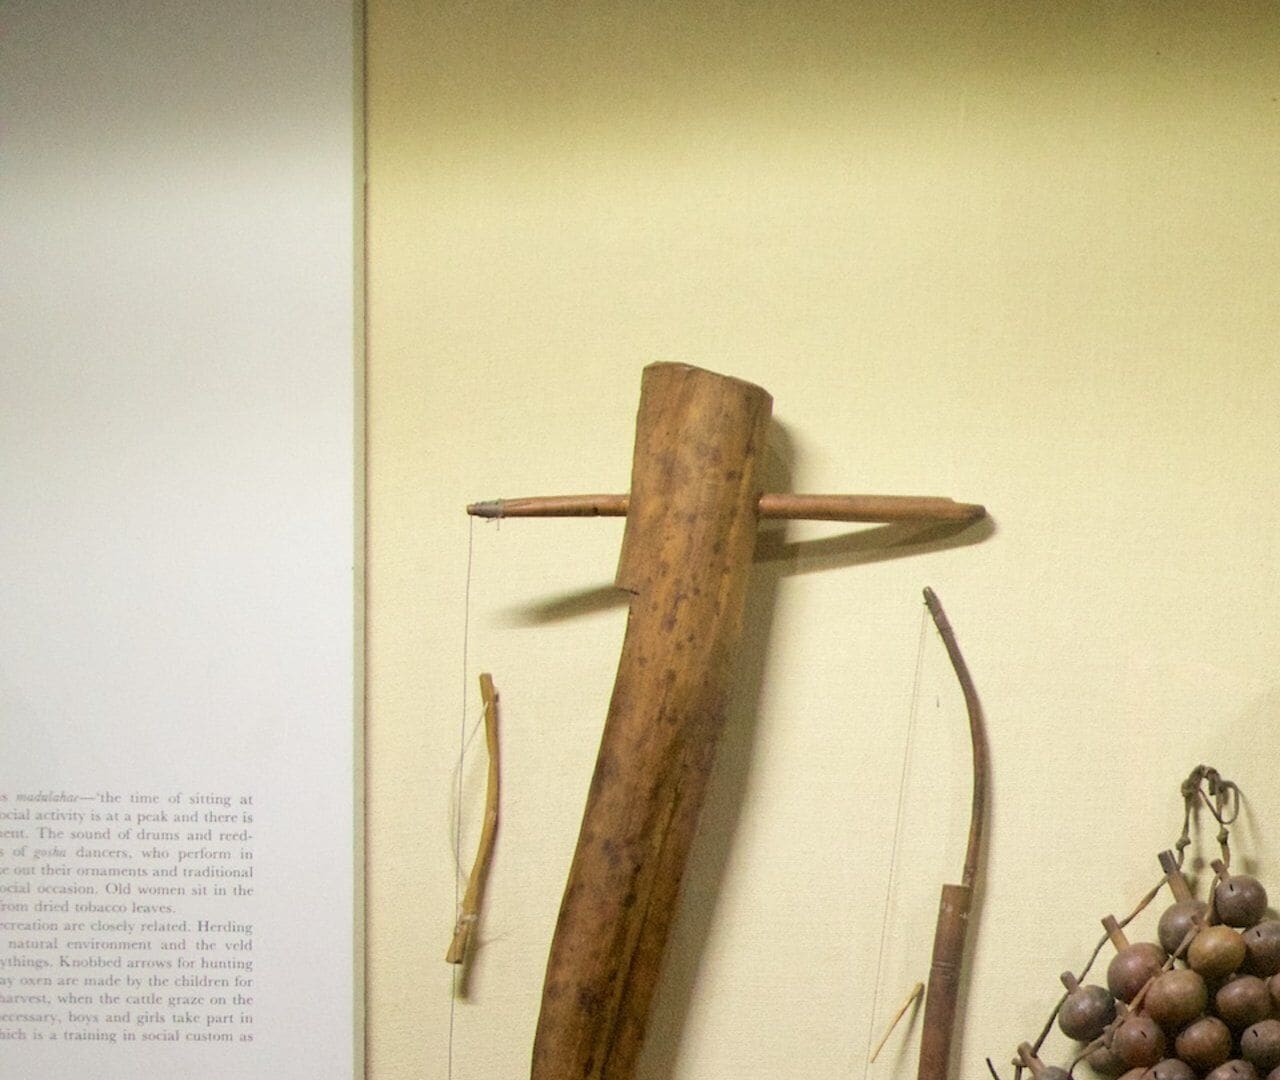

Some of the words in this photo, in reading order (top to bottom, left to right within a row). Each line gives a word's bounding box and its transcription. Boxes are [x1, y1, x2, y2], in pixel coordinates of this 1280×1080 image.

[35, 808, 86, 824] activity
[91, 809, 102, 821] is
[106, 811, 119, 821] at
[125, 812, 132, 821] a
[137, 809, 169, 825] peak
[174, 810, 199, 822] and
[204, 810, 239, 823] there
[243, 811, 254, 823] is
[37, 881, 99, 894] occasion.
[105, 882, 132, 895] Old
[138, 886, 186, 895] women
[192, 883, 207, 895] sit
[214, 883, 227, 896] in
[233, 883, 254, 896] the
[34, 899, 70, 912] dried
[75, 900, 128, 913] tobacco
[132, 901, 176, 913] leaves.
[9, 937, 59, 949] natural
[67, 937, 152, 950] environment
[161, 938, 187, 950] and
[196, 938, 217, 950] the
[226, 938, 253, 950] veld
[33, 1028, 44, 1040] is
[49, 1031, 58, 1040] a
[64, 1028, 117, 1044] training
[123, 1029, 137, 1041] in
[142, 1029, 181, 1041] social
[185, 1031, 234, 1042] custom
[240, 1033, 254, 1042] as
